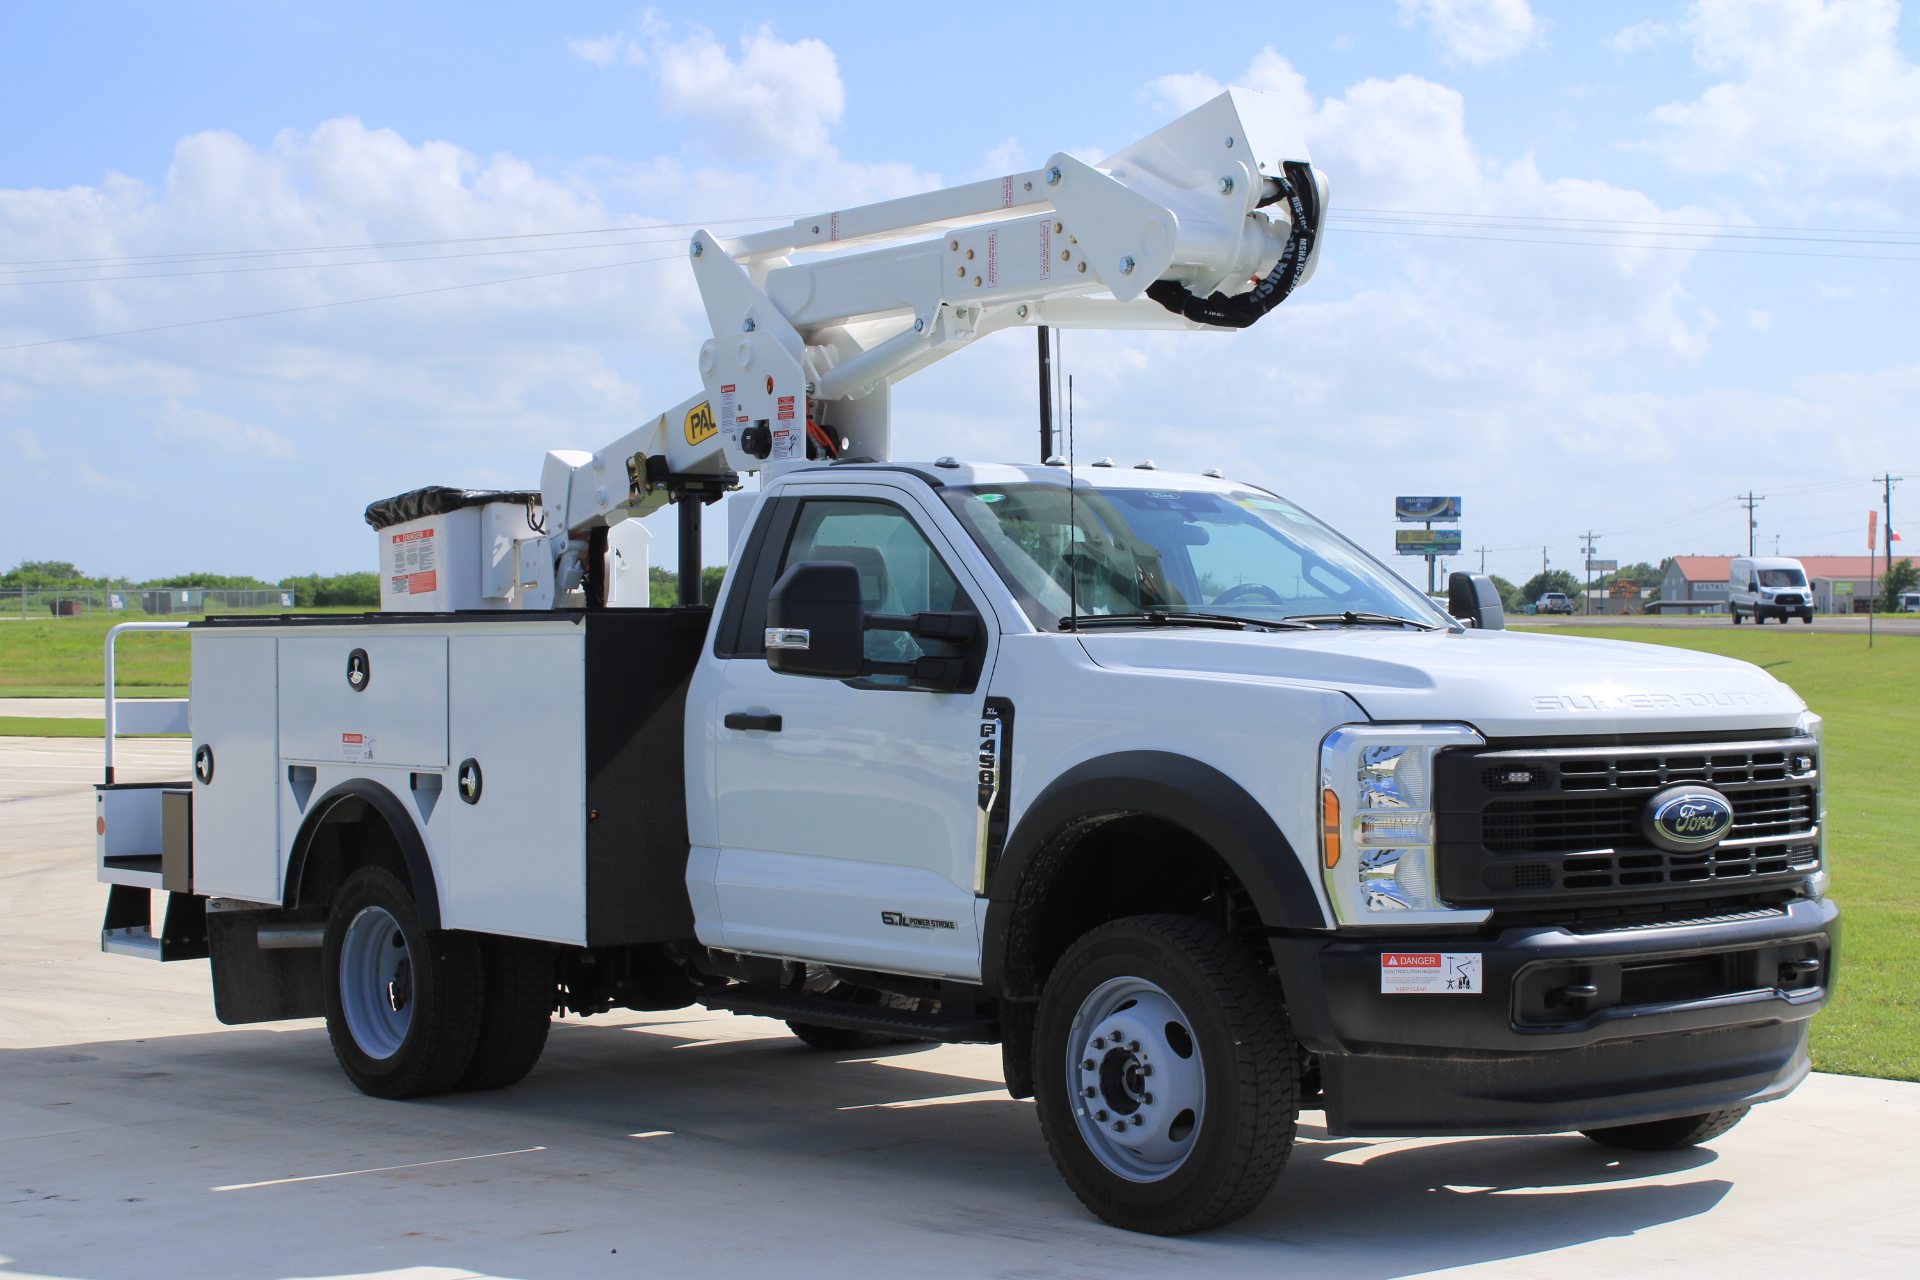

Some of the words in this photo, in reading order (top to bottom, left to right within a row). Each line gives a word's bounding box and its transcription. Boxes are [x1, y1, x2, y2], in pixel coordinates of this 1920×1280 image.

[1297, 238, 1307, 261] MSHA
[402, 531, 424, 541] DANGER
[986, 707, 998, 715] XL
[978, 722, 997, 785] F450
[1675, 804, 1718, 832] Ford
[881, 910, 910, 927] 6.7L
[909, 917, 931, 927] POWER
[930, 919, 956, 930] STROKE
[1400, 956, 1436, 965] DANGER
